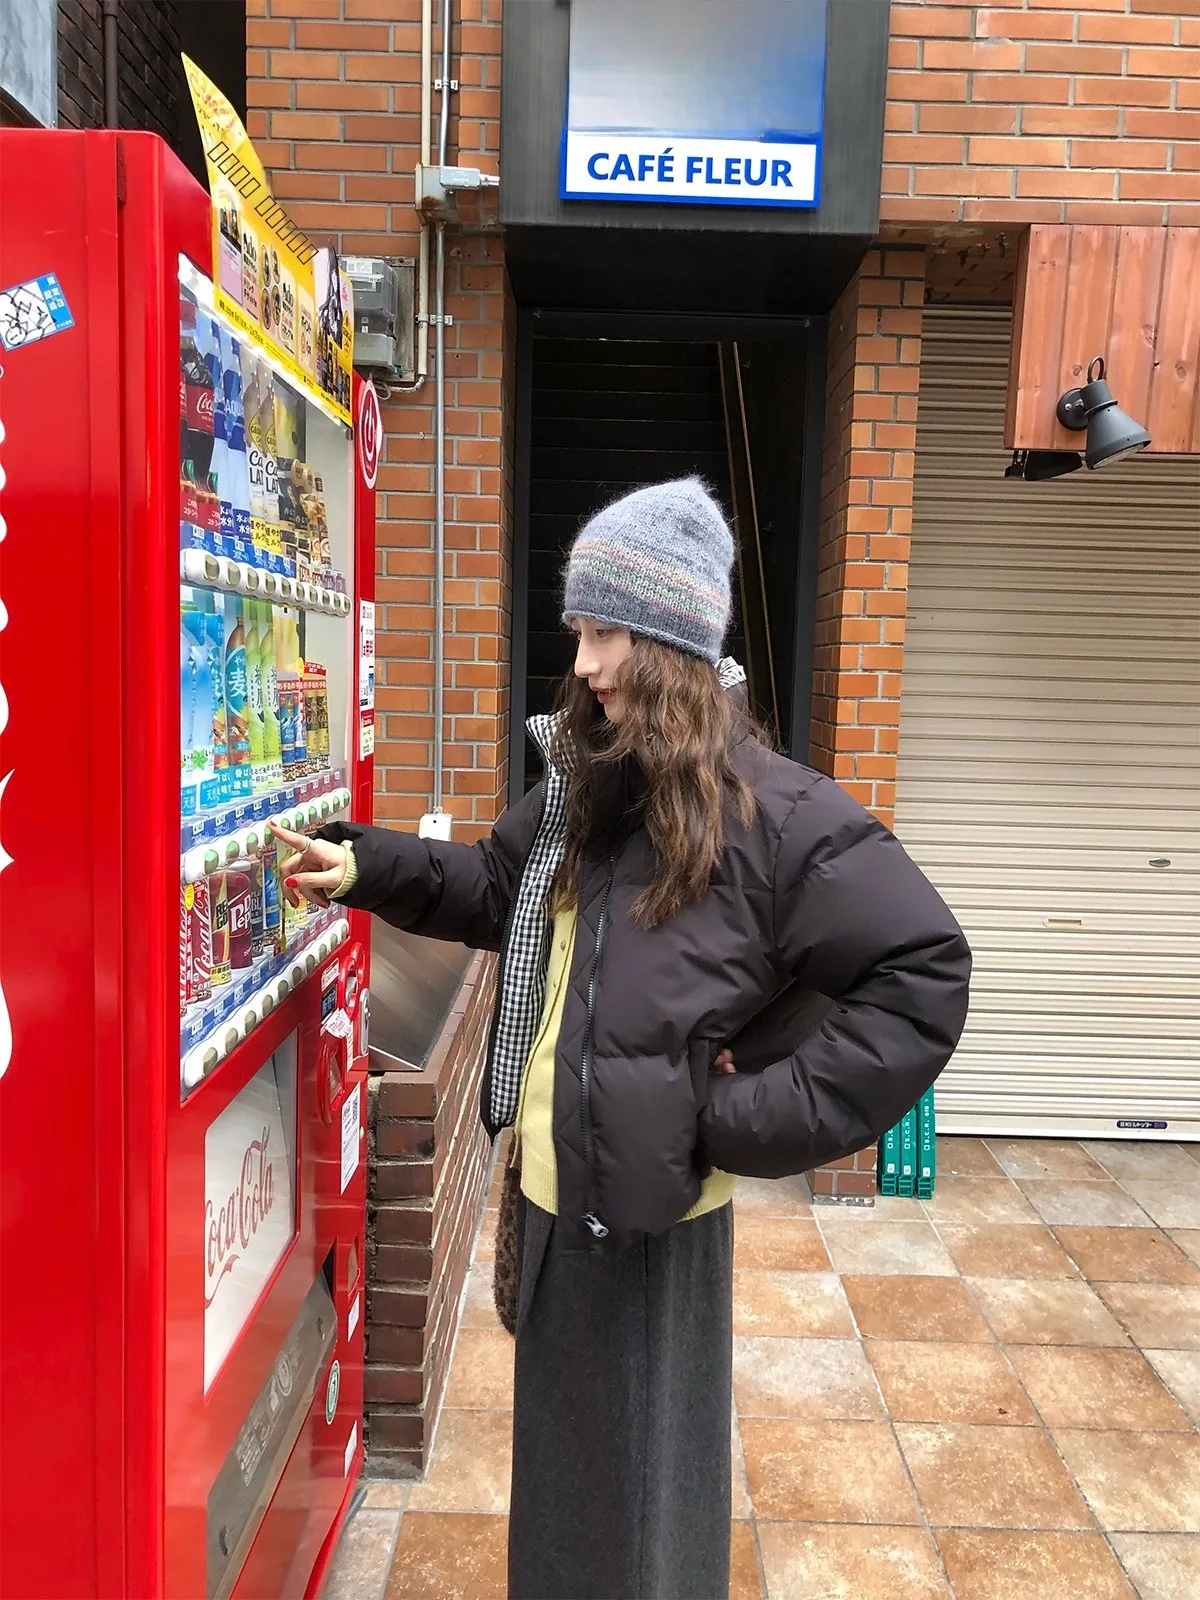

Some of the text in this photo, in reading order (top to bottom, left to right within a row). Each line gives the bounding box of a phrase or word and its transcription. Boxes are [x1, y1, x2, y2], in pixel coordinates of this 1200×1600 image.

[587, 147, 793, 187] CAFÉ FLEUR
[228, 668, 247, 697] 麦
